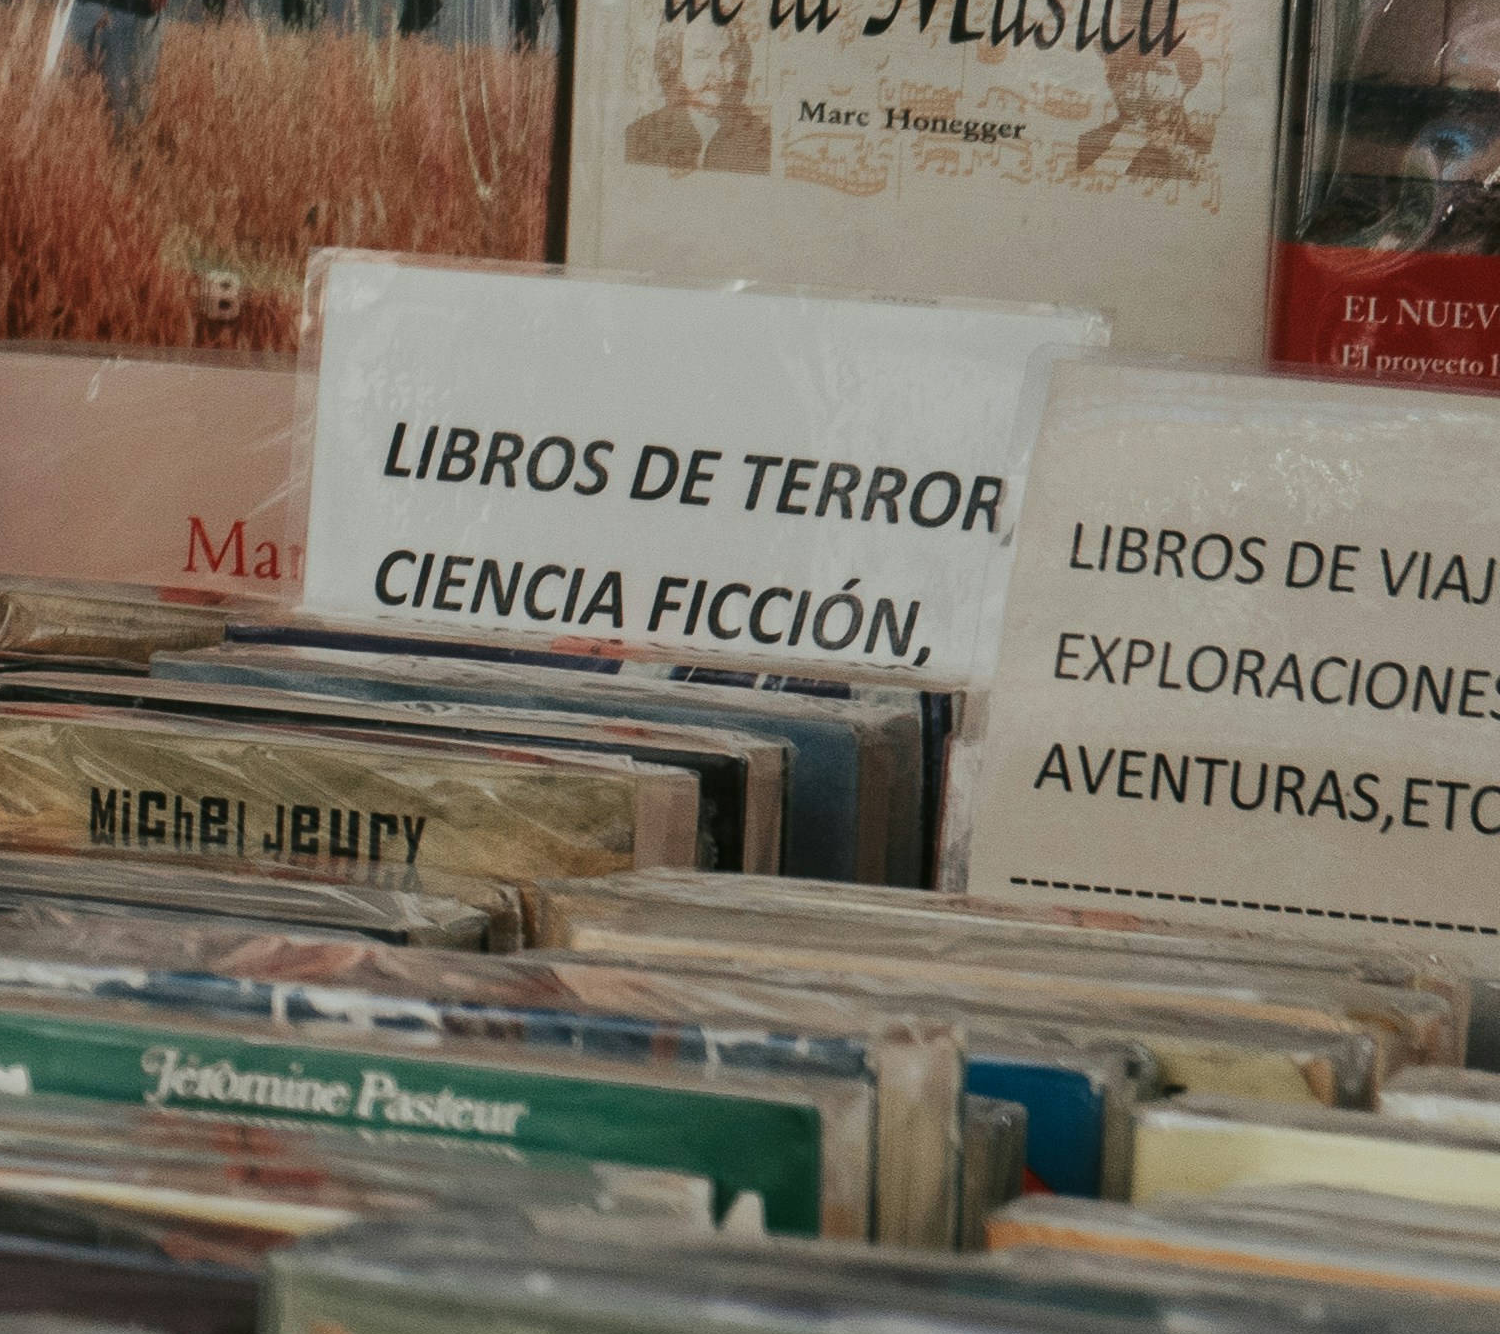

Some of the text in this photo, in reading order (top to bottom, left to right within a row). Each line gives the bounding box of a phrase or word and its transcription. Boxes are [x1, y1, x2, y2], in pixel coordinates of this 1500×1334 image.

[798, 97, 1027, 145] Marc Honegger
[1342, 294, 1389, 325] EL
[1341, 344, 1485, 380] El proyecto
[381, 422, 617, 497] LIBROS
[629, 443, 722, 509] DE
[1069, 522, 1266, 587] LIBROS
[1284, 541, 1365, 595] DE
[370, 547, 934, 667] CIENCIA FICCIÓN,
[356, 1068, 529, 1138] Pasteur
